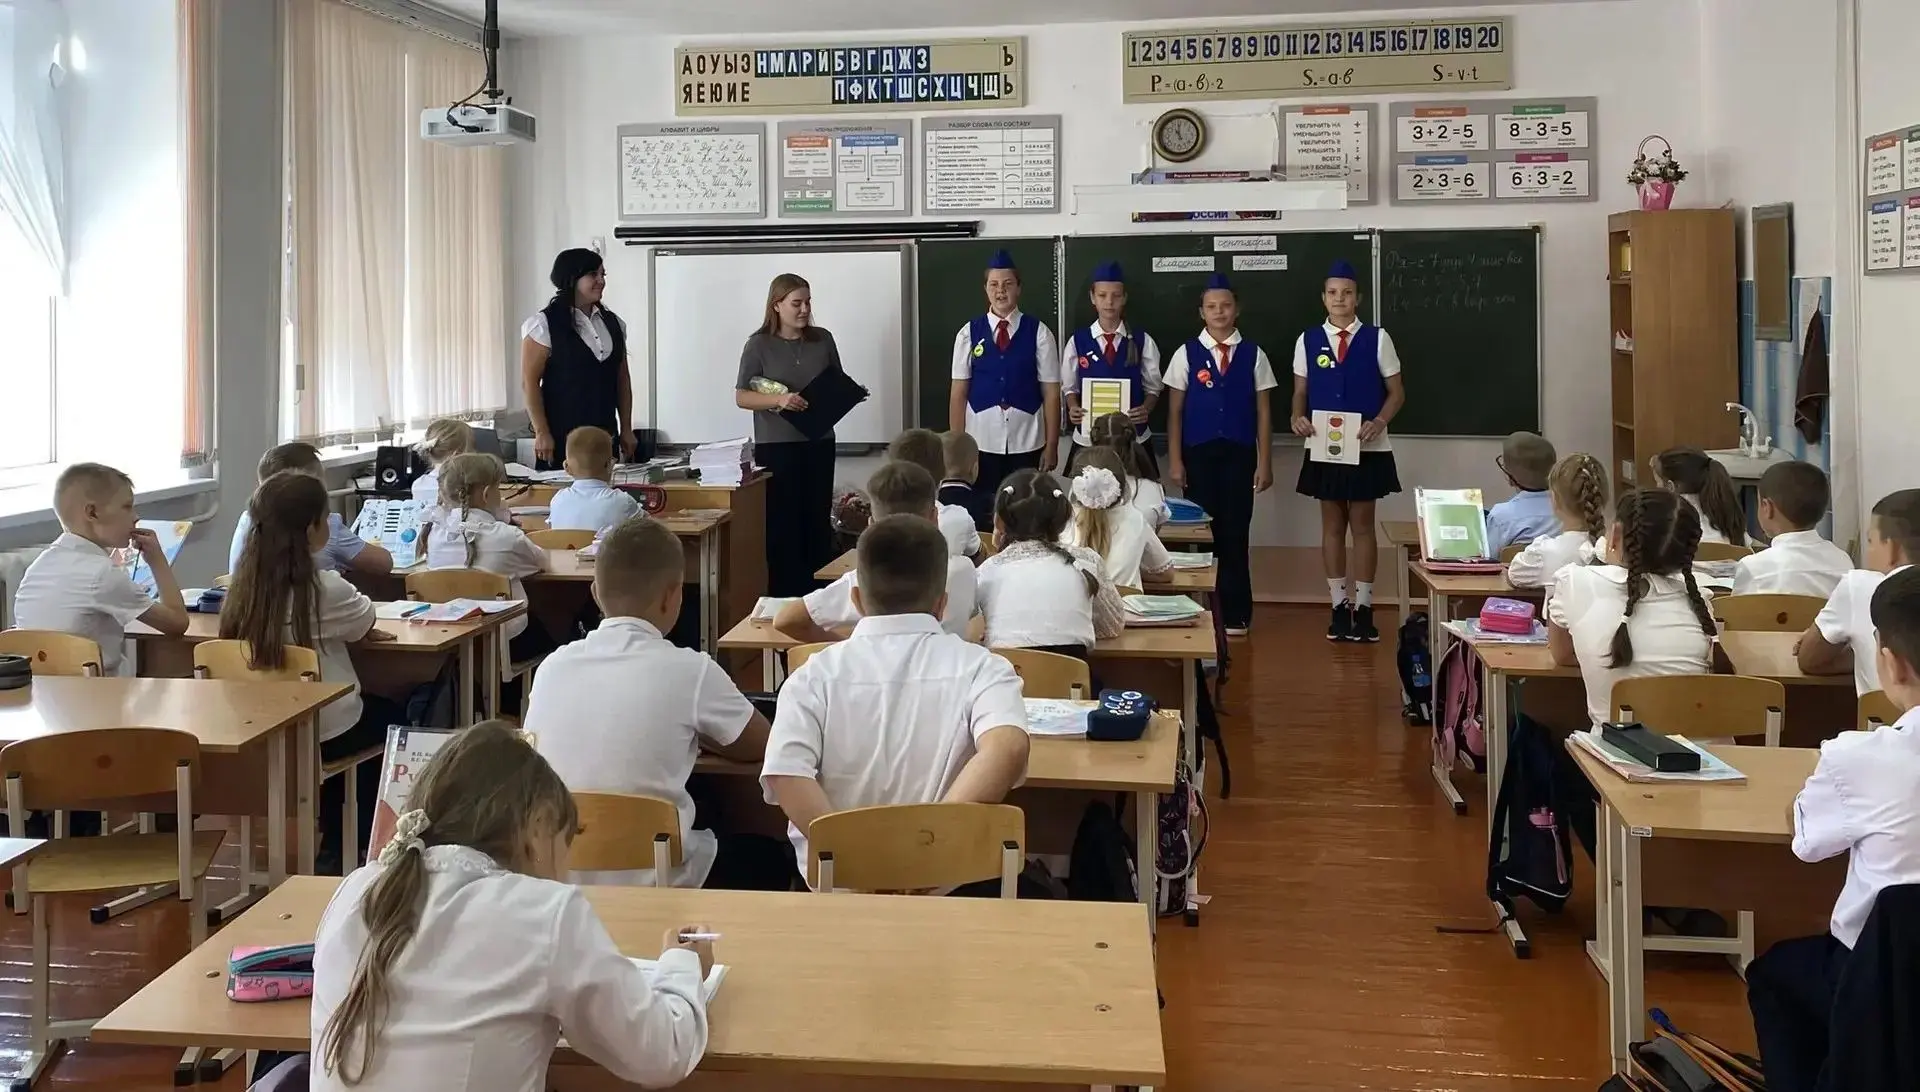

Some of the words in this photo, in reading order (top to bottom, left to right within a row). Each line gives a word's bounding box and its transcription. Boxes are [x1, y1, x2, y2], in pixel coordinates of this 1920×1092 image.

[1131, 41, 1137, 62] 1
[1142, 41, 1152, 62] 2
[1155, 40, 1166, 61] 3
[1170, 39, 1181, 60] 4
[1186, 38, 1197, 60] 5
[1202, 38, 1213, 59] 6
[1216, 37, 1227, 58] 7
[1232, 36, 1242, 58] 8
[1247, 36, 1258, 57] 9
[1264, 35, 1280, 56] 10
[1286, 34, 1297, 55] 11
[1303, 33, 1320, 54] 12
[1326, 32, 1342, 54] 13
[1348, 31, 1364, 53] 14
[1370, 30, 1386, 52] 15
[1391, 30, 1408, 51] 16
[1412, 29, 1428, 50] 17
[1433, 28, 1450, 50] 18
[1455, 27, 1472, 49] 19
[1477, 26, 1499, 48] 20
[1412, 126, 1423, 140] 3
[1437, 125, 1448, 139] 2
[1463, 124, 1474, 138] 5
[1510, 123, 1520, 137] 8
[1537, 122, 1547, 136] 3
[1561, 121, 1572, 135] 5
[1413, 174, 1423, 188] 2
[1438, 173, 1448, 187] 3
[1464, 172, 1474, 187] 6
[1512, 172, 1522, 185] 6
[1537, 171, 1547, 185] 3
[1563, 170, 1573, 184] 2
[1193, 210, 1229, 219] ОССИИ
